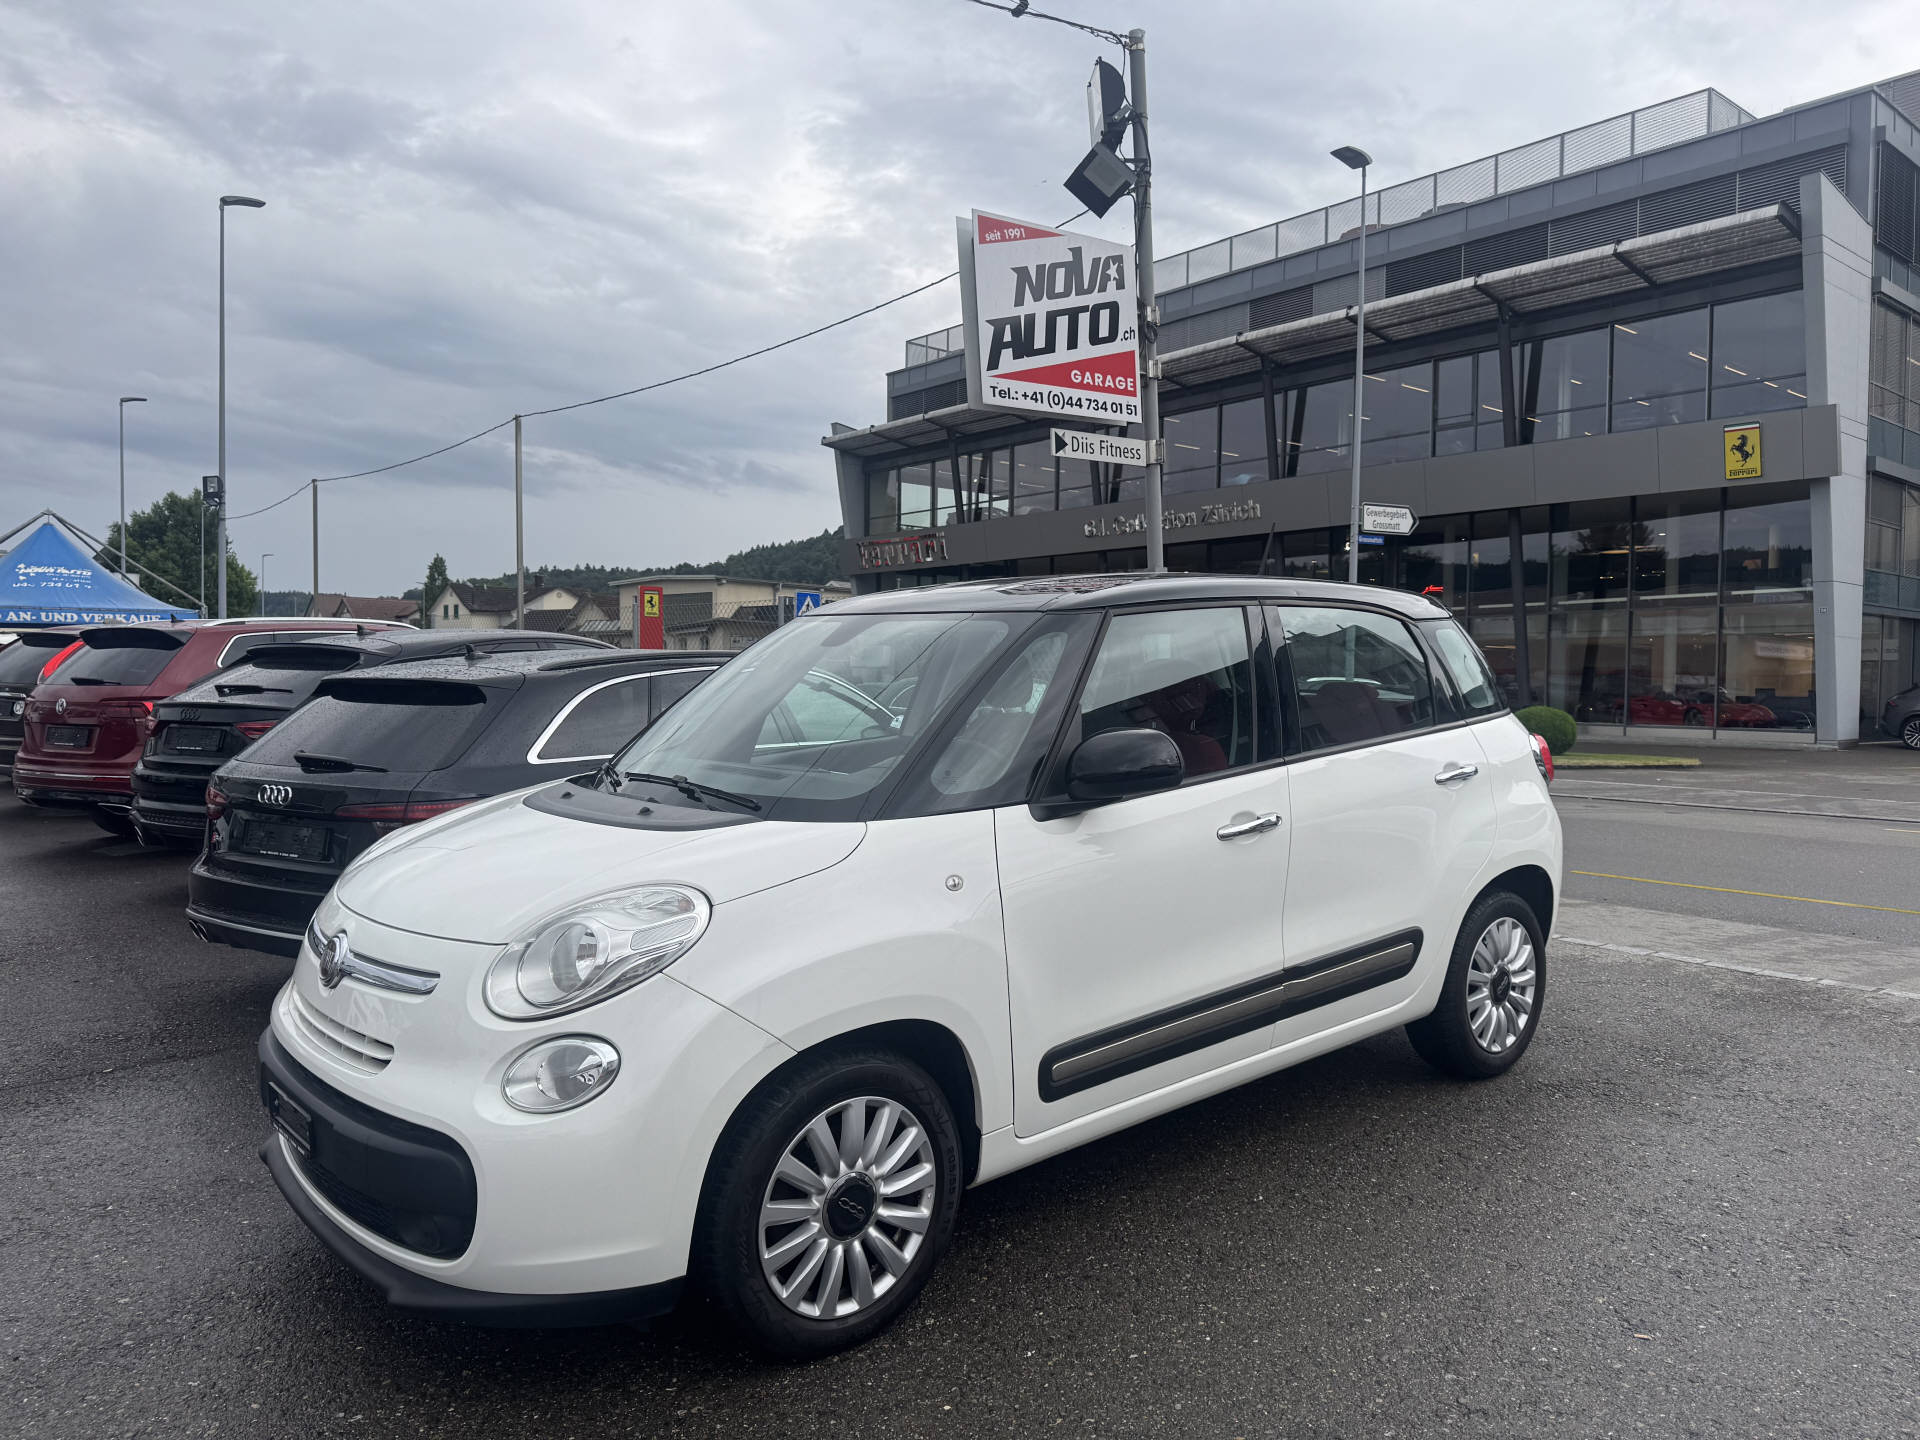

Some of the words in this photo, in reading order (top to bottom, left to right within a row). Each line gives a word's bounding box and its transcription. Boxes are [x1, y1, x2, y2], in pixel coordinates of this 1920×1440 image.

[985, 230, 1001, 241] seit
[1004, 228, 1026, 239] 1991
[1010, 246, 1126, 308] NOVA
[985, 300, 1120, 372] AUTO
[1070, 369, 1135, 391] GARAGE
[990, 385, 1019, 401] Tel.:
[1022, 391, 1044, 404] +41
[1047, 390, 1083, 409] (0)44
[1086, 398, 1108, 413] 734
[1110, 402, 1123, 414] 01
[1126, 404, 1138, 416] 51
[1071, 435, 1095, 455] Diis
[1099, 439, 1142, 460] Fitness
[1112, 509, 1198, 536] Colltion
[1200, 500, 1262, 524] Zürich
[1365, 507, 1408, 520] Gewerbegebiet
[1372, 519, 1401, 531] Grossmatt
[6, 611, 37, 622] AN-
[40, 612, 78, 623] UND
